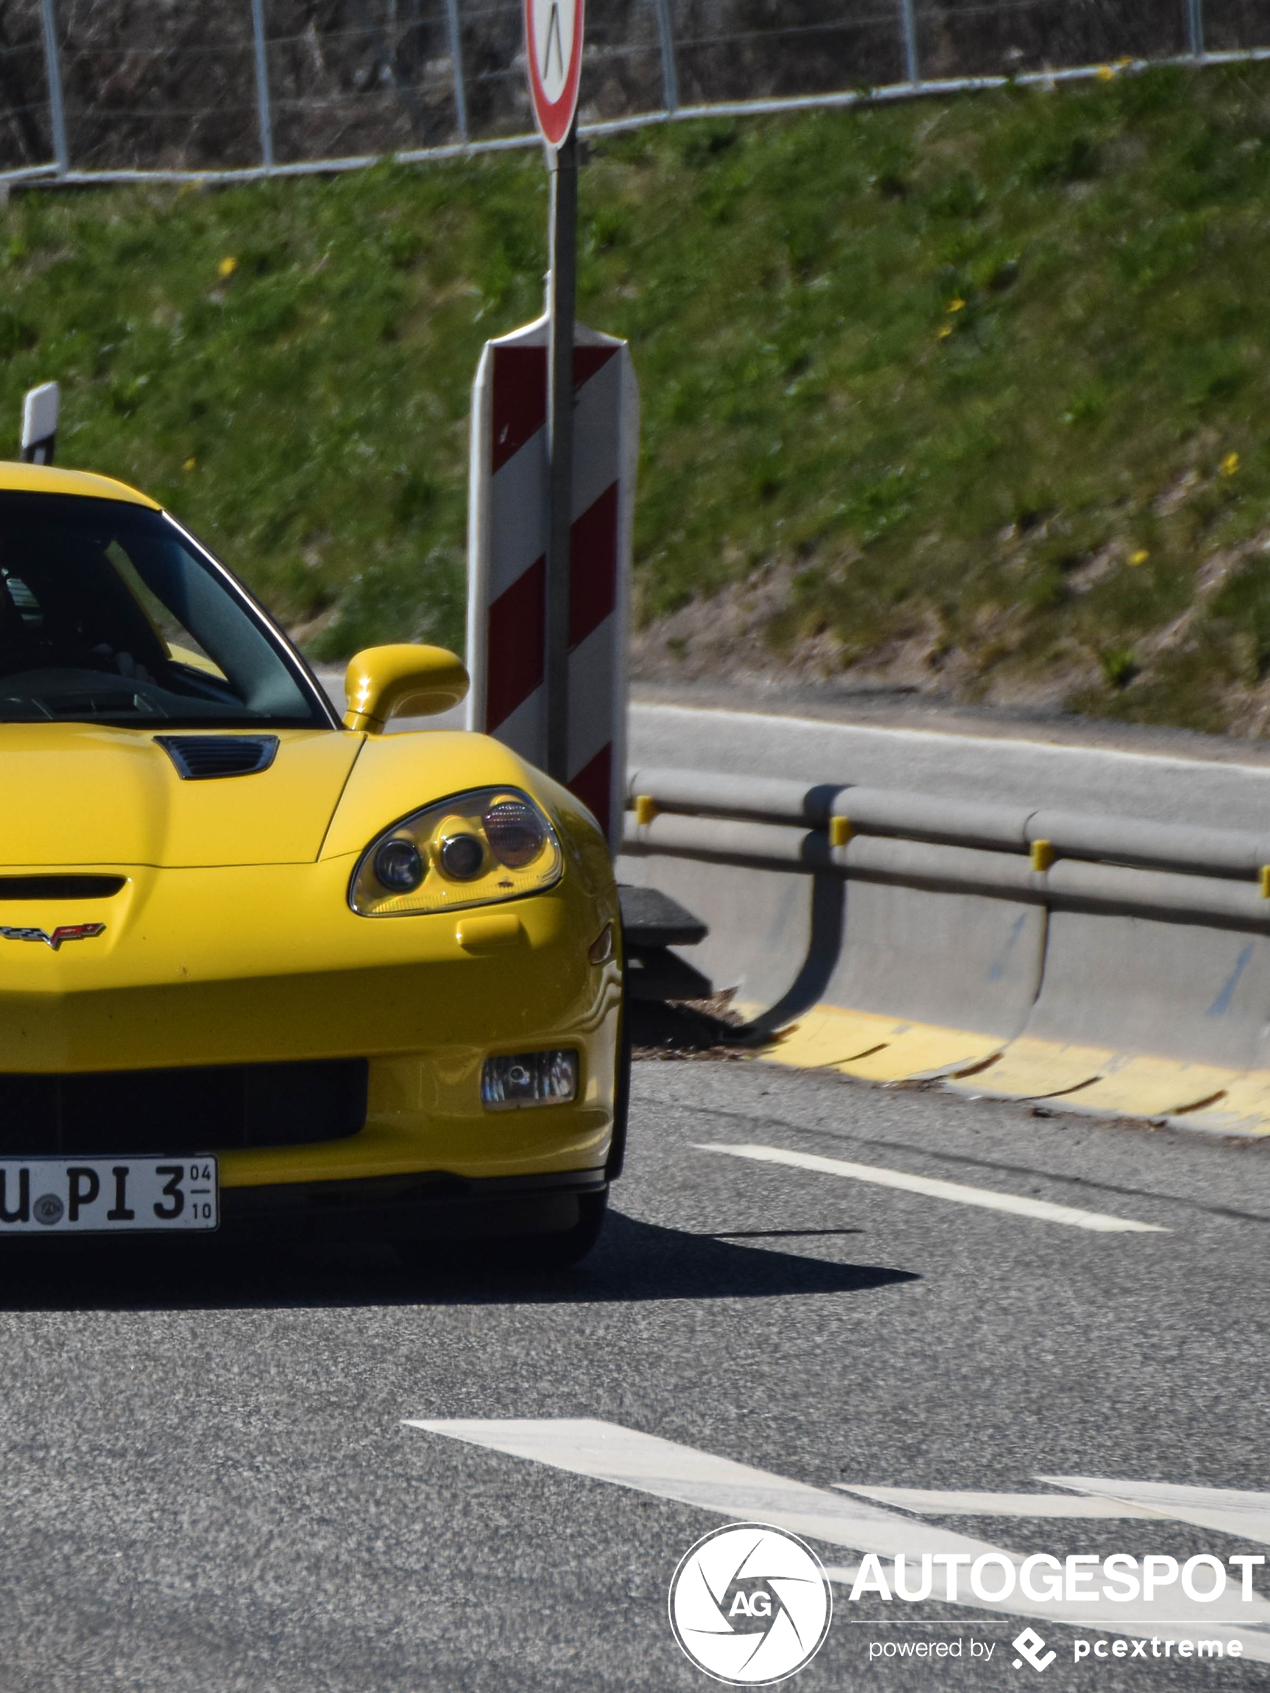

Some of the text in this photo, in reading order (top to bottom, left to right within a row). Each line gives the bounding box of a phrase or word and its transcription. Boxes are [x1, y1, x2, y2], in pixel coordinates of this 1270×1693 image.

[190, 1163, 212, 1182] 04
[66, 1165, 136, 1223] PI
[153, 1164, 186, 1221] 3
[191, 1202, 212, 1220] 10
